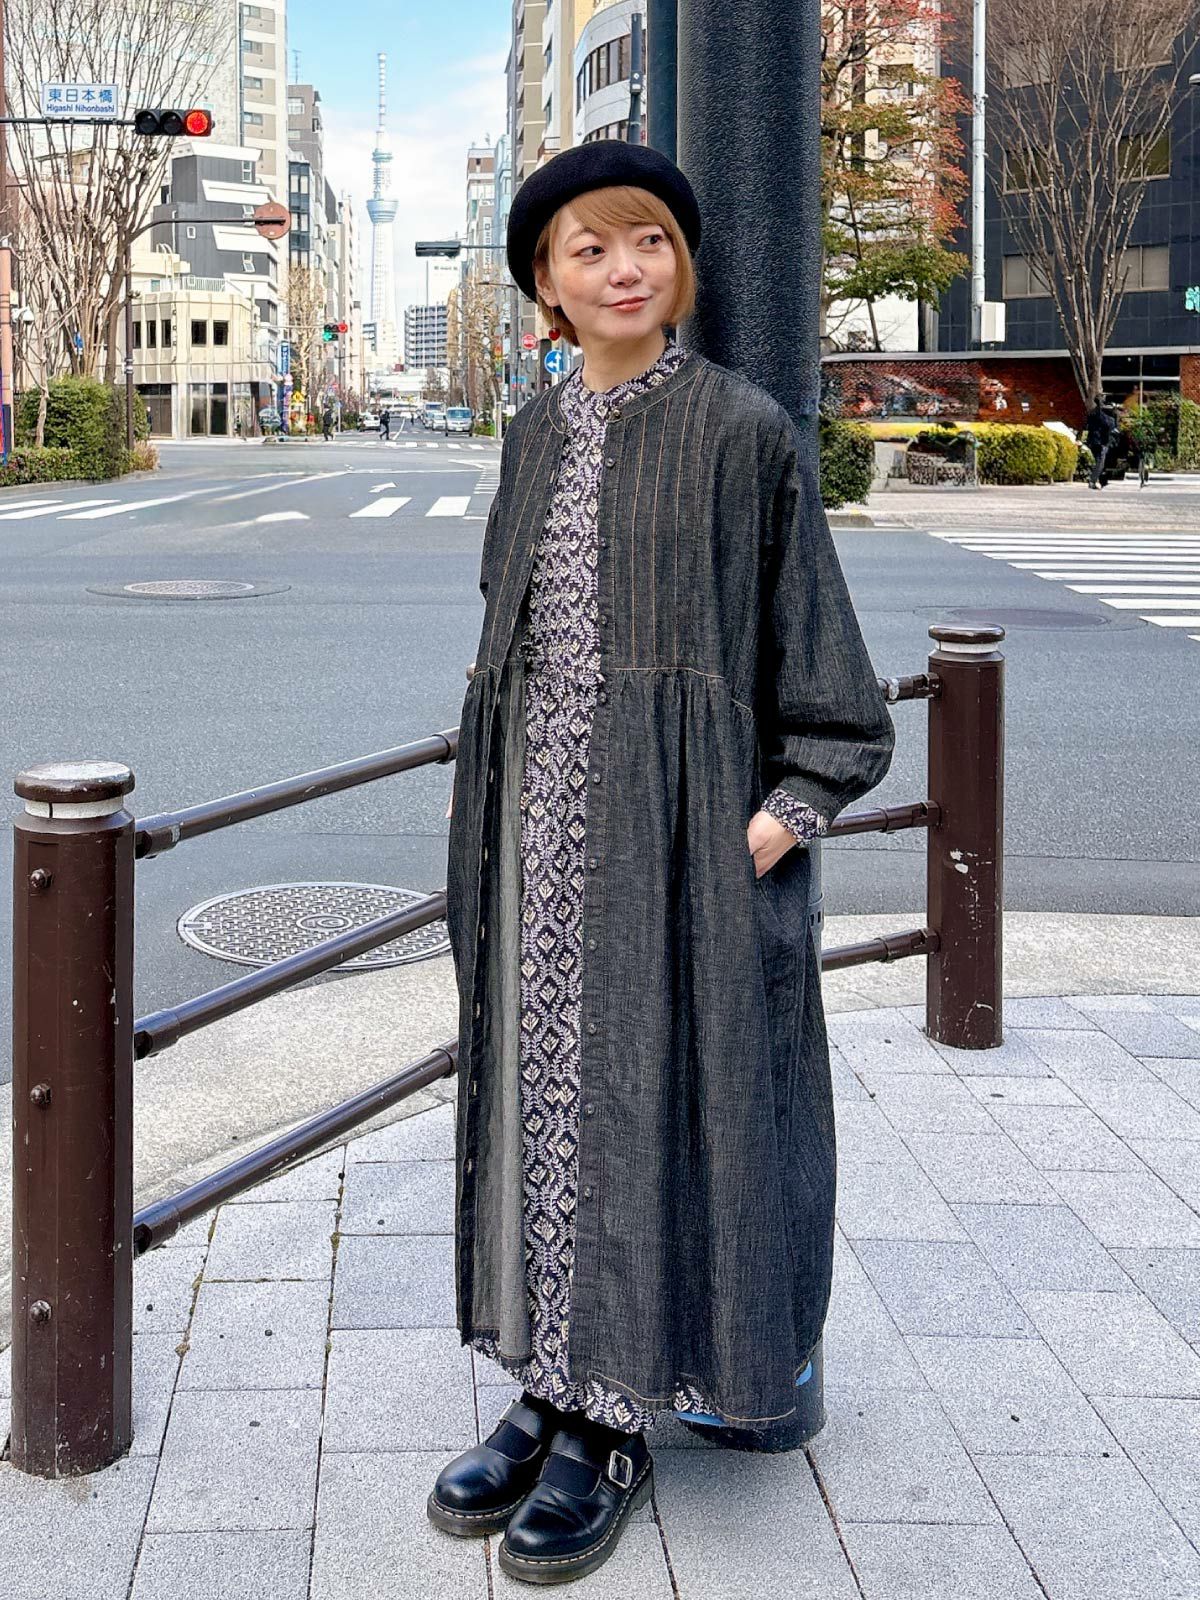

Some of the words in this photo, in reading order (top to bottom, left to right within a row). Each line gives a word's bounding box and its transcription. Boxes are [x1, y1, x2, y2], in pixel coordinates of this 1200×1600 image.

[48, 88, 113, 103] 東日本橋
[46, 104, 73, 113] Higashi
[75, 104, 115, 113] Nihonbashi
